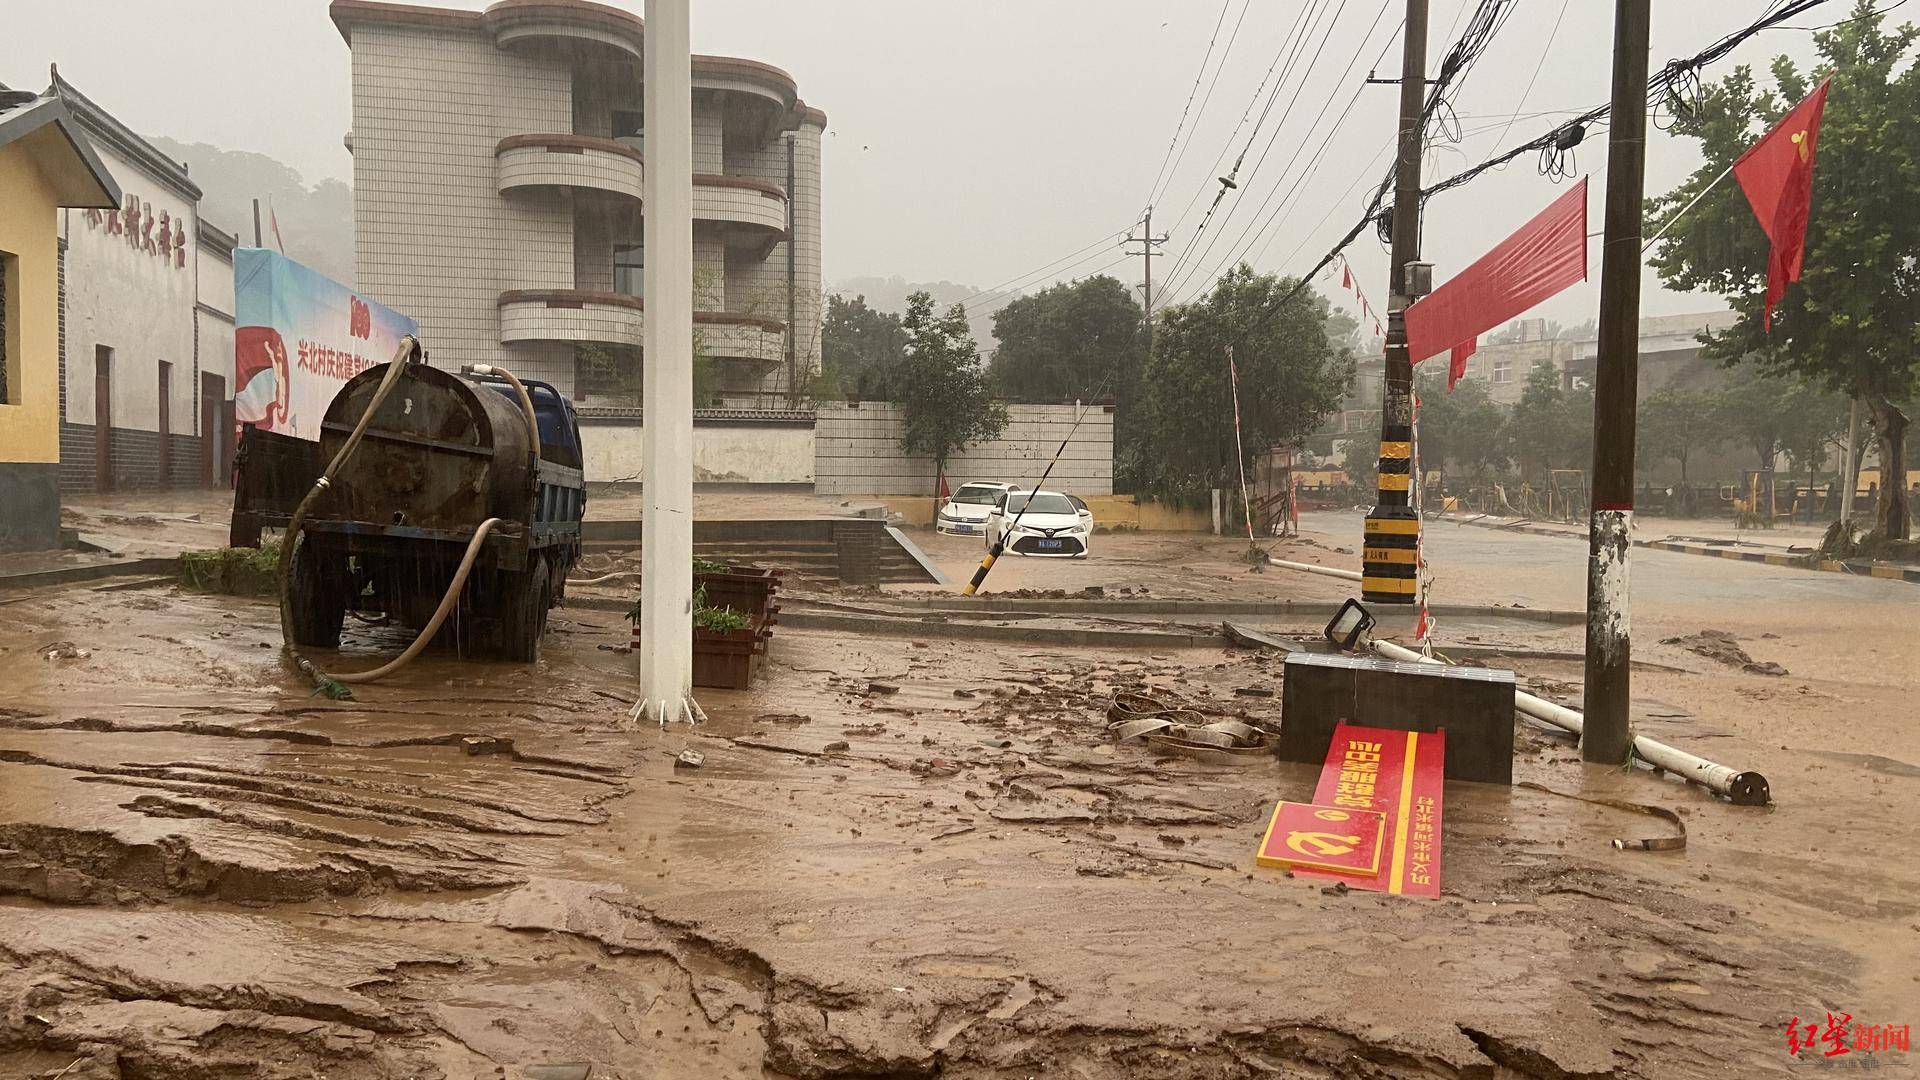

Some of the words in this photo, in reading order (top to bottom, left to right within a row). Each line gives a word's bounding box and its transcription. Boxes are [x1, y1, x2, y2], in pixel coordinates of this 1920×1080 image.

[1333, 740, 1383, 808] 党群服务中心
[1411, 796, 1434, 886] 巩义市米河镇米北村
